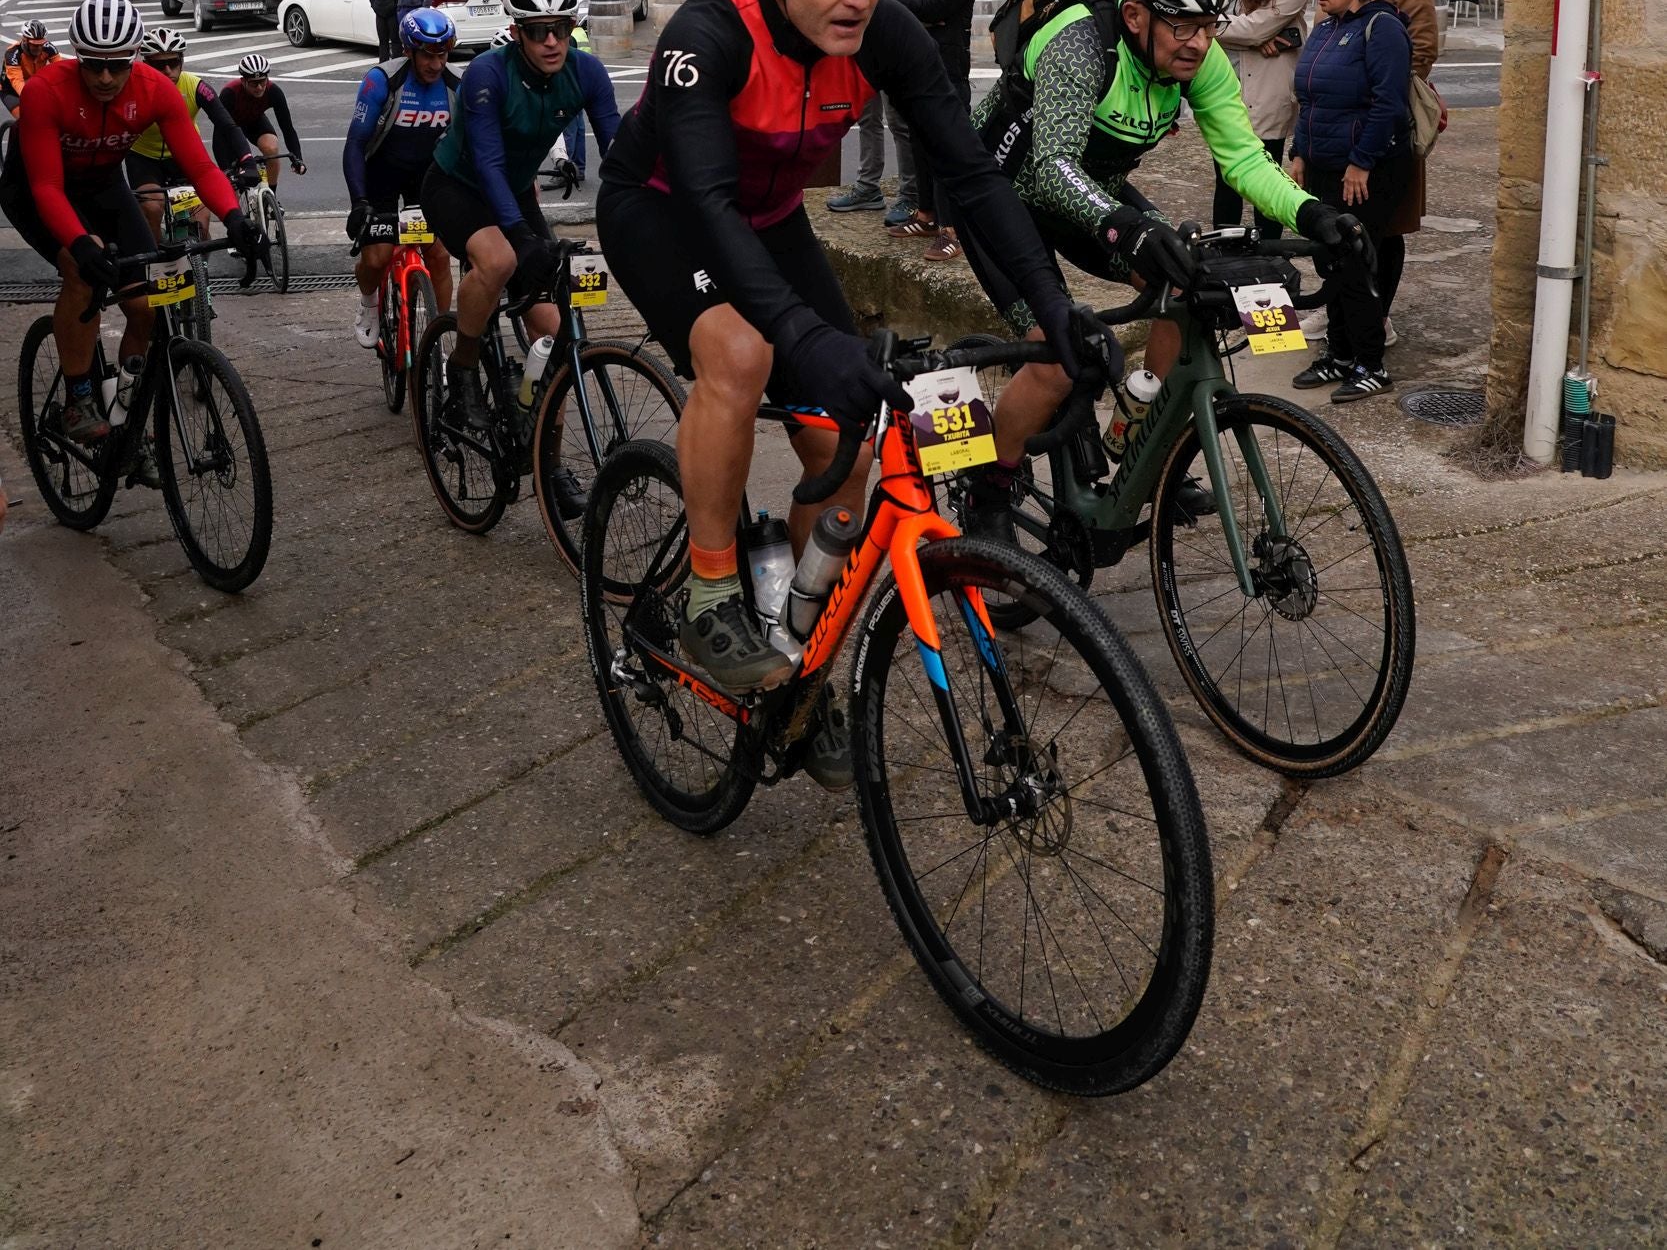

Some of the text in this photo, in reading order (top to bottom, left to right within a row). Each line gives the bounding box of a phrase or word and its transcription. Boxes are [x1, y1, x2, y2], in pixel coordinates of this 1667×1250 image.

[663, 50, 699, 87] 76
[394, 110, 450, 128] EPR
[994, 122, 1022, 167] KLOS
[369, 224, 393, 233] EPR
[407, 221, 428, 231] 536
[157, 274, 186, 290] 854
[579, 273, 601, 288] 332
[1251, 308, 1287, 328] 935
[931, 404, 975, 435] 531
[868, 588, 897, 631] POWER
[1171, 609, 1193, 657] DT SWISS
[855, 633, 870, 684] MICHELIN
